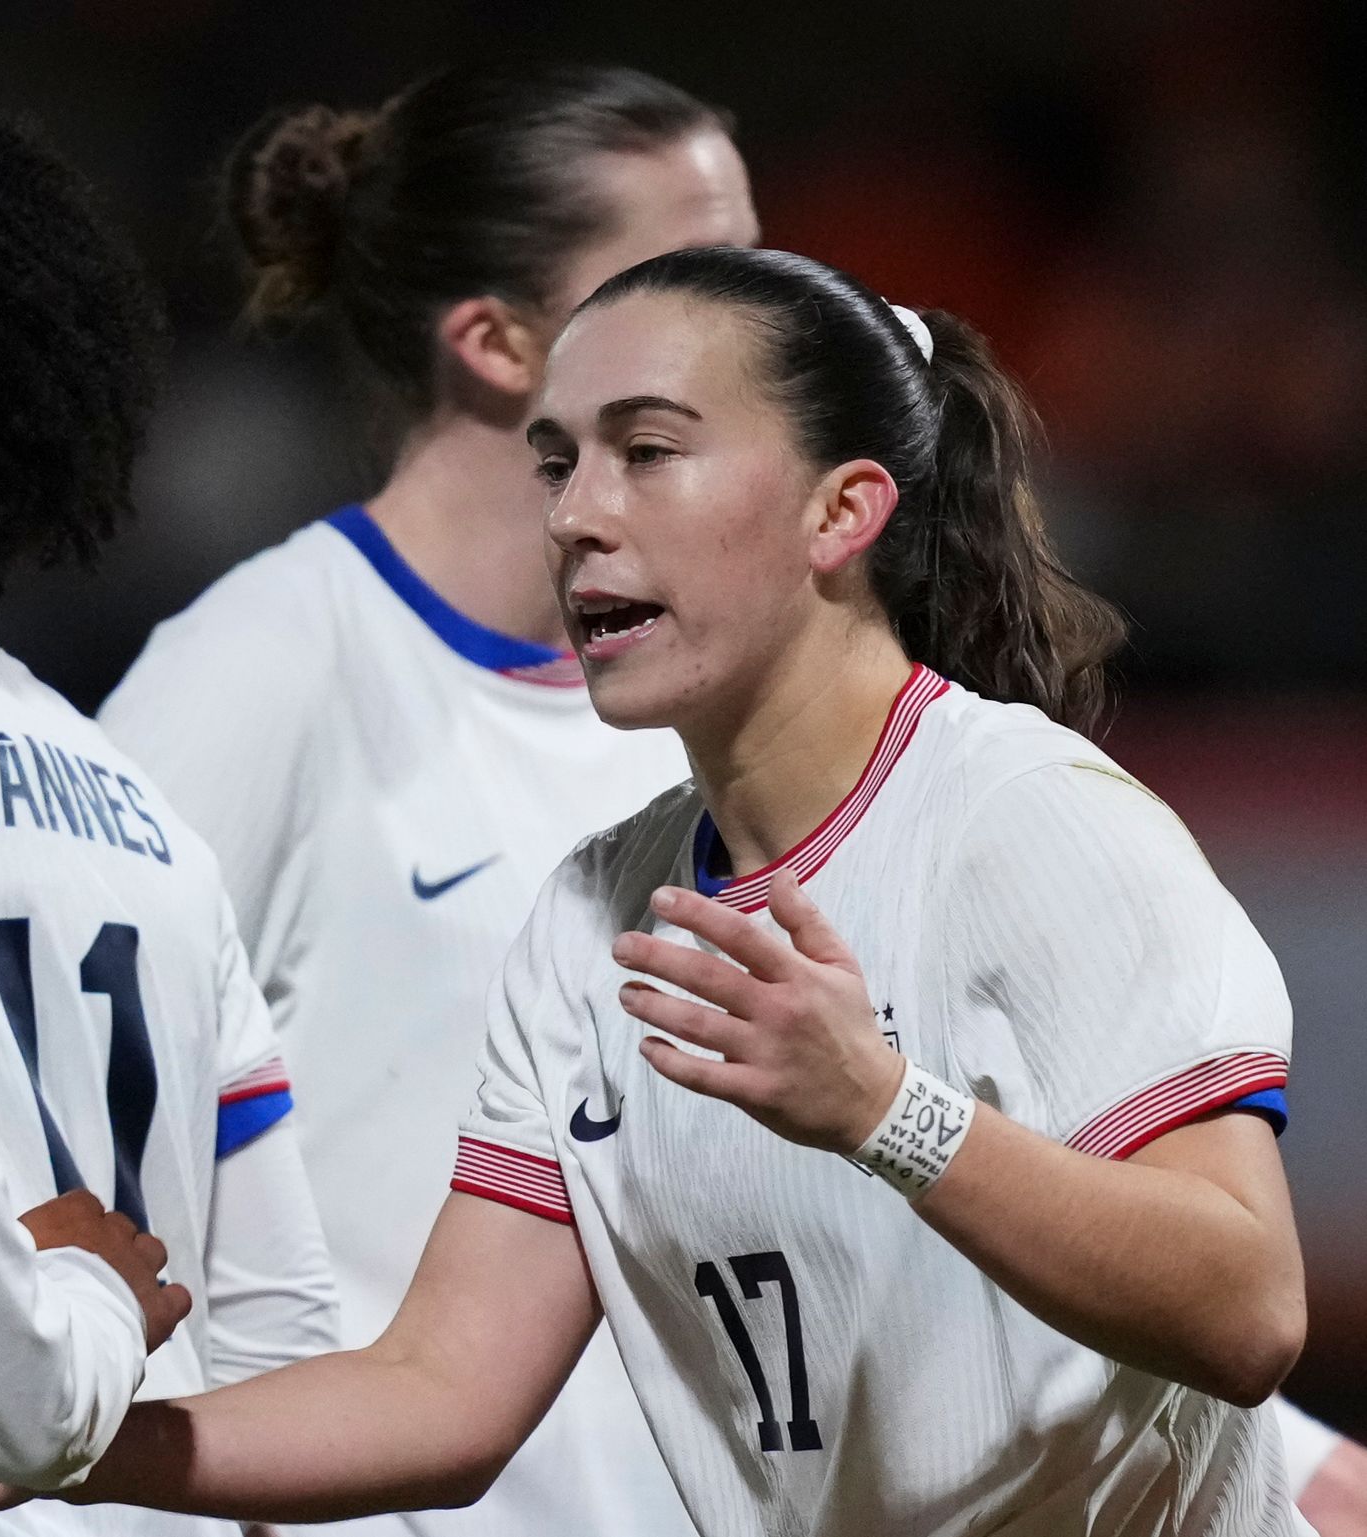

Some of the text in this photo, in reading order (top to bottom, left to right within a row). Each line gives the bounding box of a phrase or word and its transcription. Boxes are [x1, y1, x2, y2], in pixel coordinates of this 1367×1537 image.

[890, 1123, 925, 1150] FEAR
[872, 1149, 931, 1187] LOVE
[694, 1251, 823, 1451] 17
